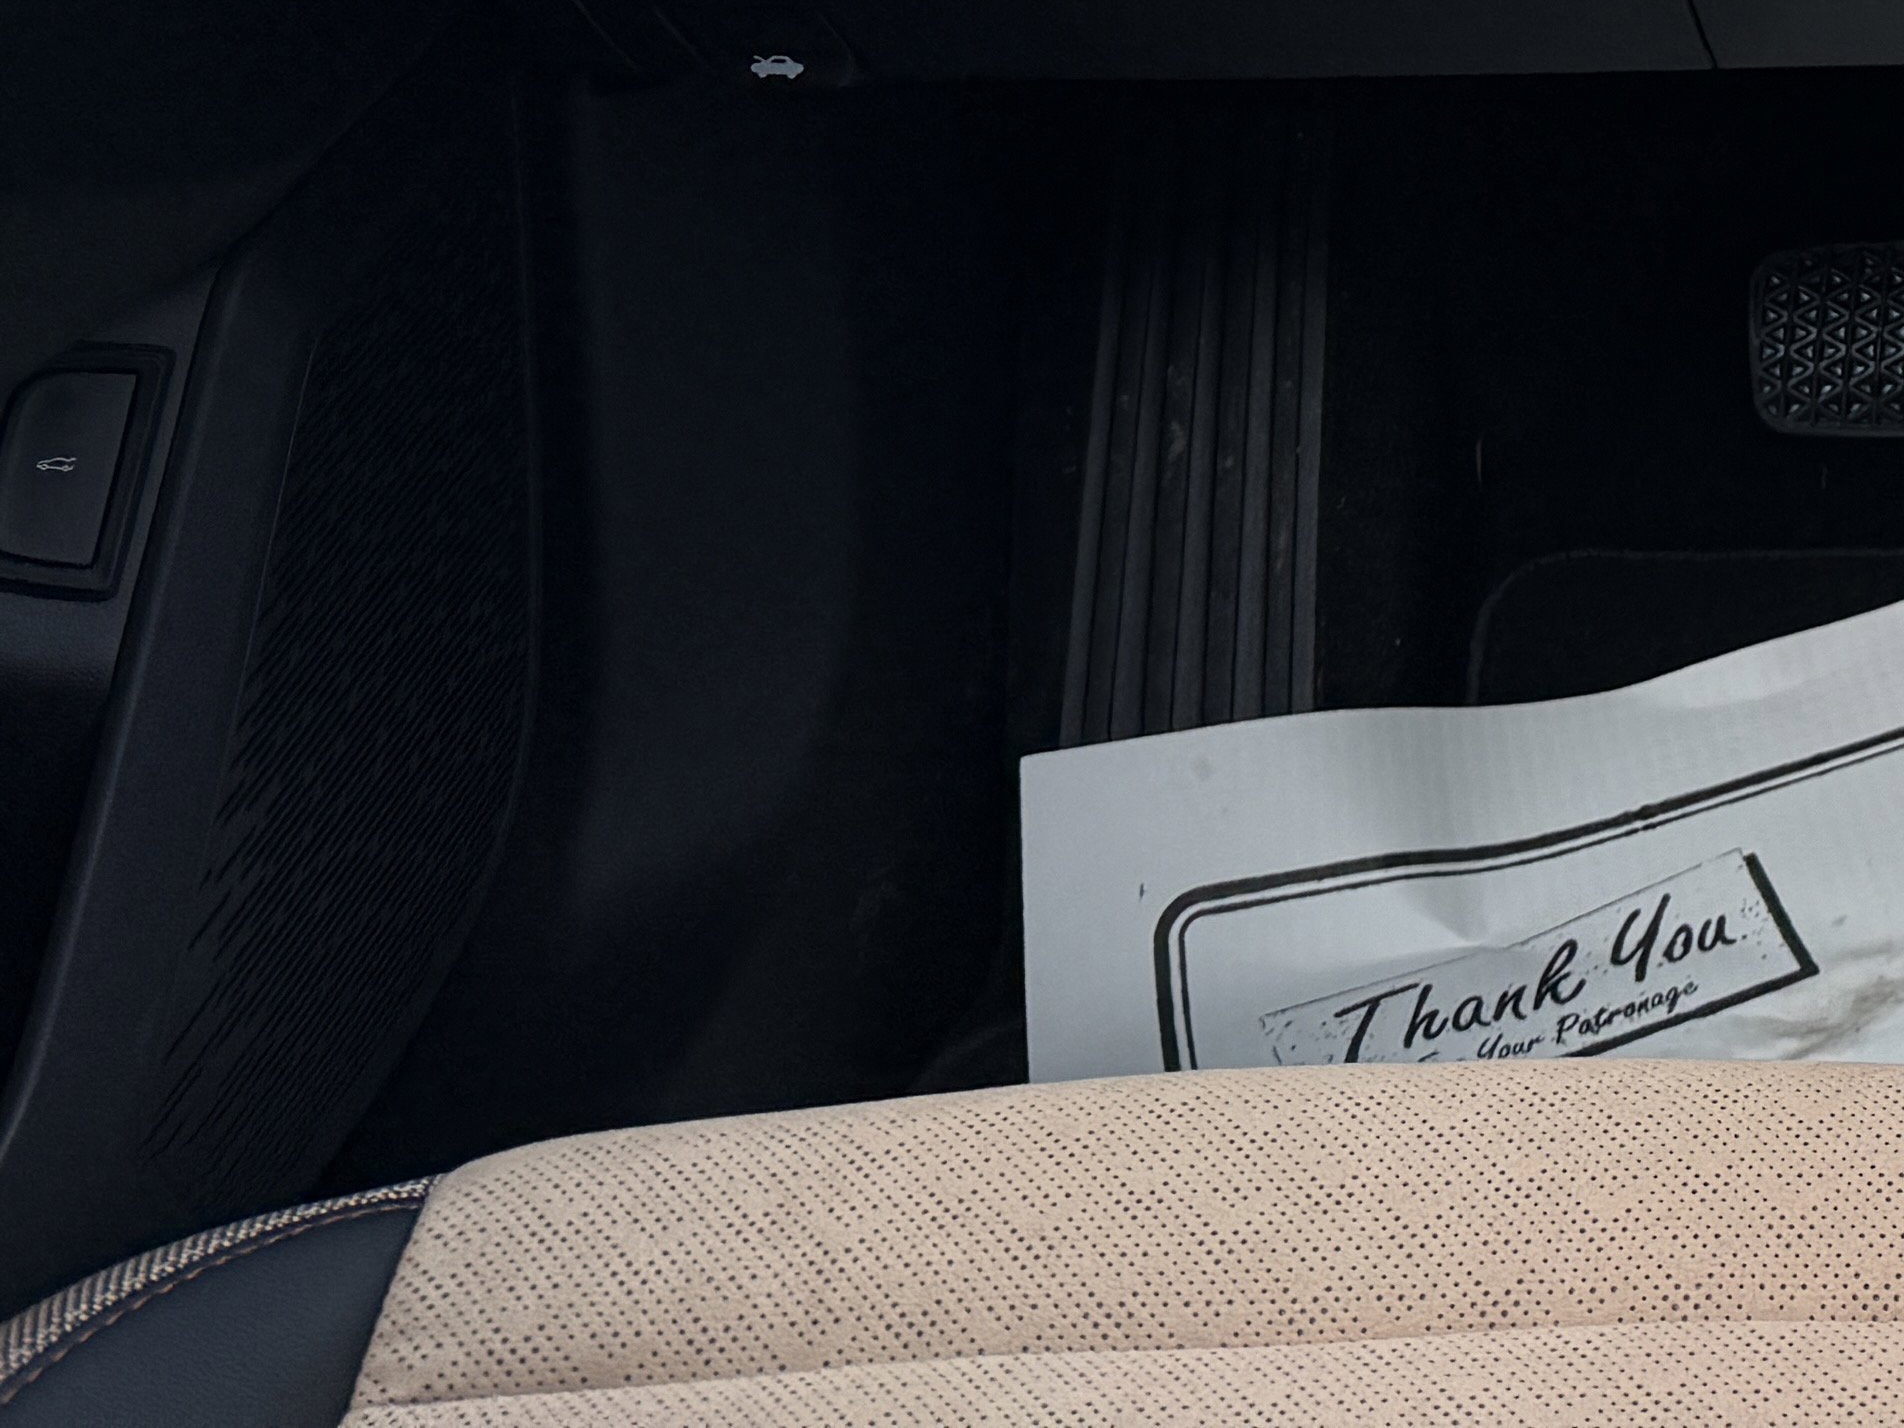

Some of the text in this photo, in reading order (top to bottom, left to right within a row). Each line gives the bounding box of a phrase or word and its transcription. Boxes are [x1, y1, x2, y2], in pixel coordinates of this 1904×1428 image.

[1333, 939, 1587, 1063] Thank
[1477, 978, 1700, 1061] Your Patronage
